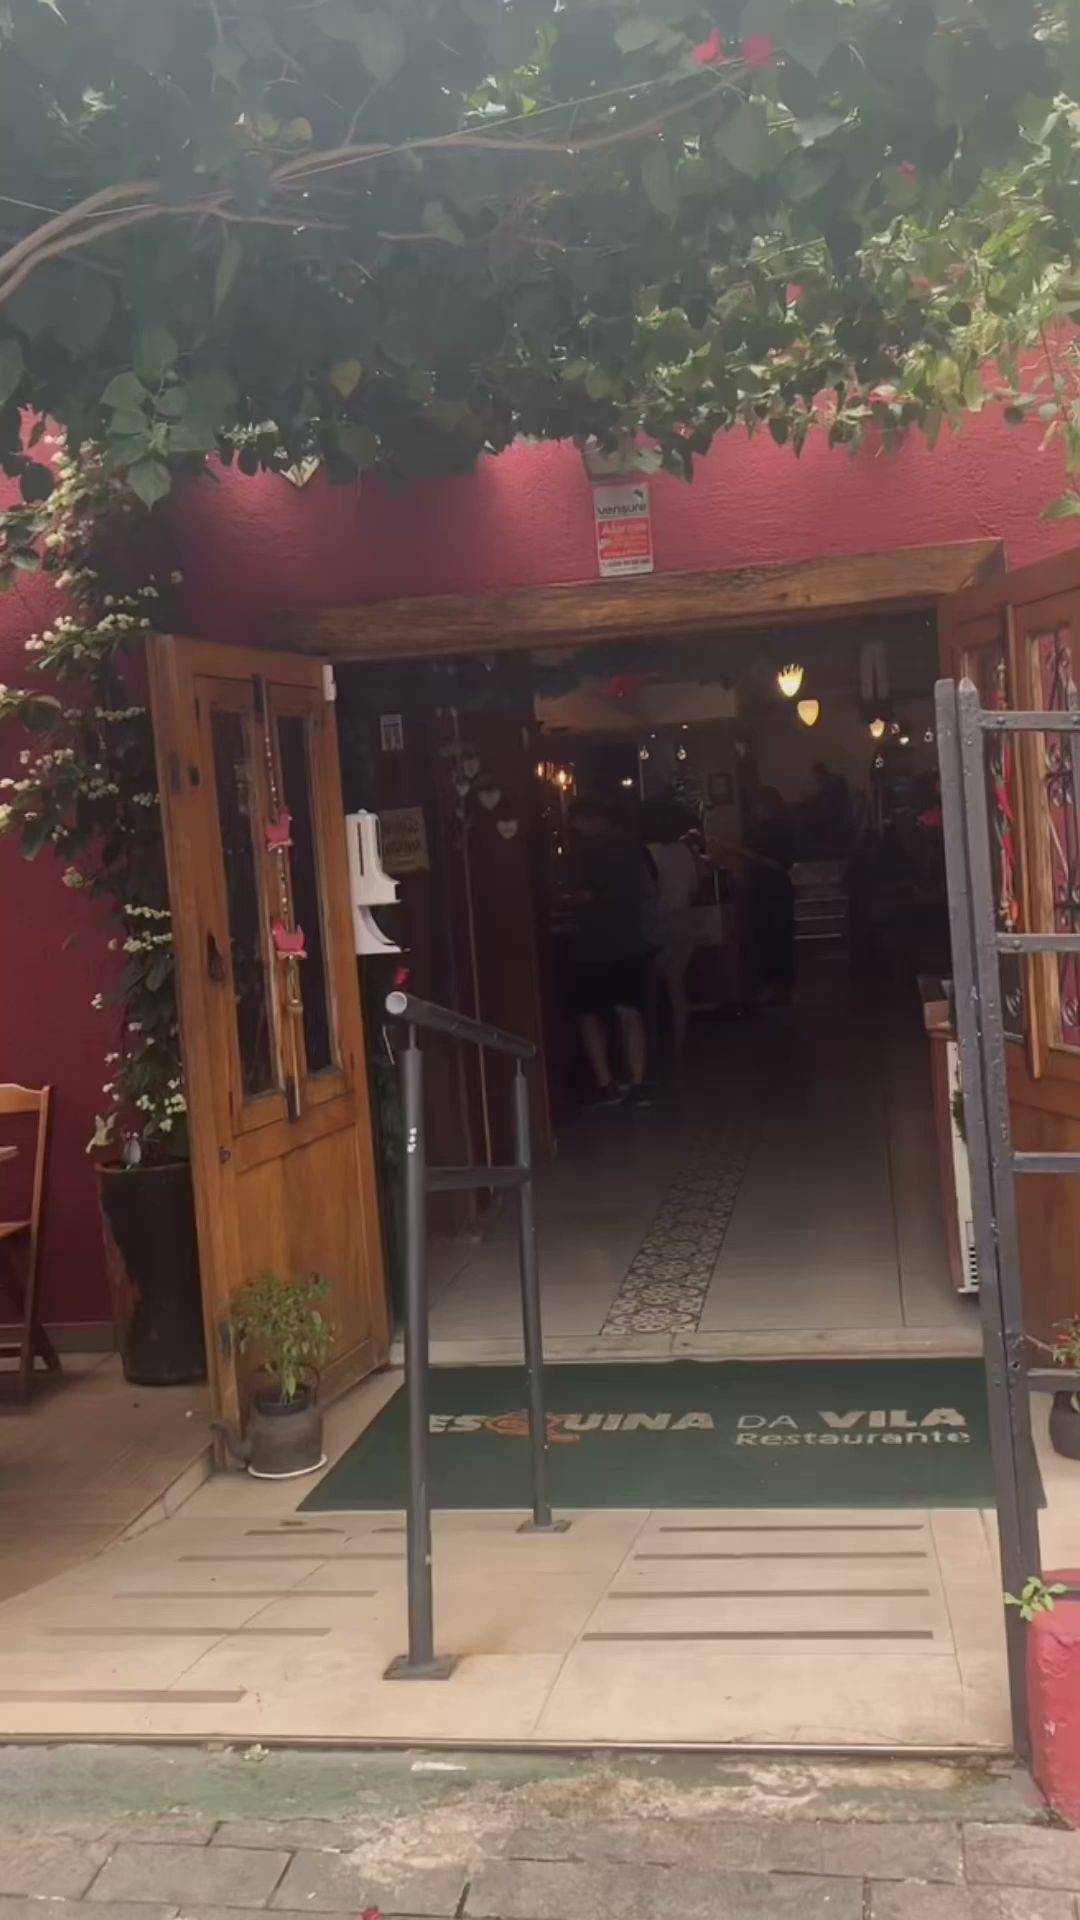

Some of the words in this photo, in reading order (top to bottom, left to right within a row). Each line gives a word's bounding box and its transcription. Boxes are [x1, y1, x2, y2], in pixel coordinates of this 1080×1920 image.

[736, 1415, 798, 1428] DA
[818, 1408, 967, 1428] VILA
[735, 1431, 971, 1445] Restaurante
